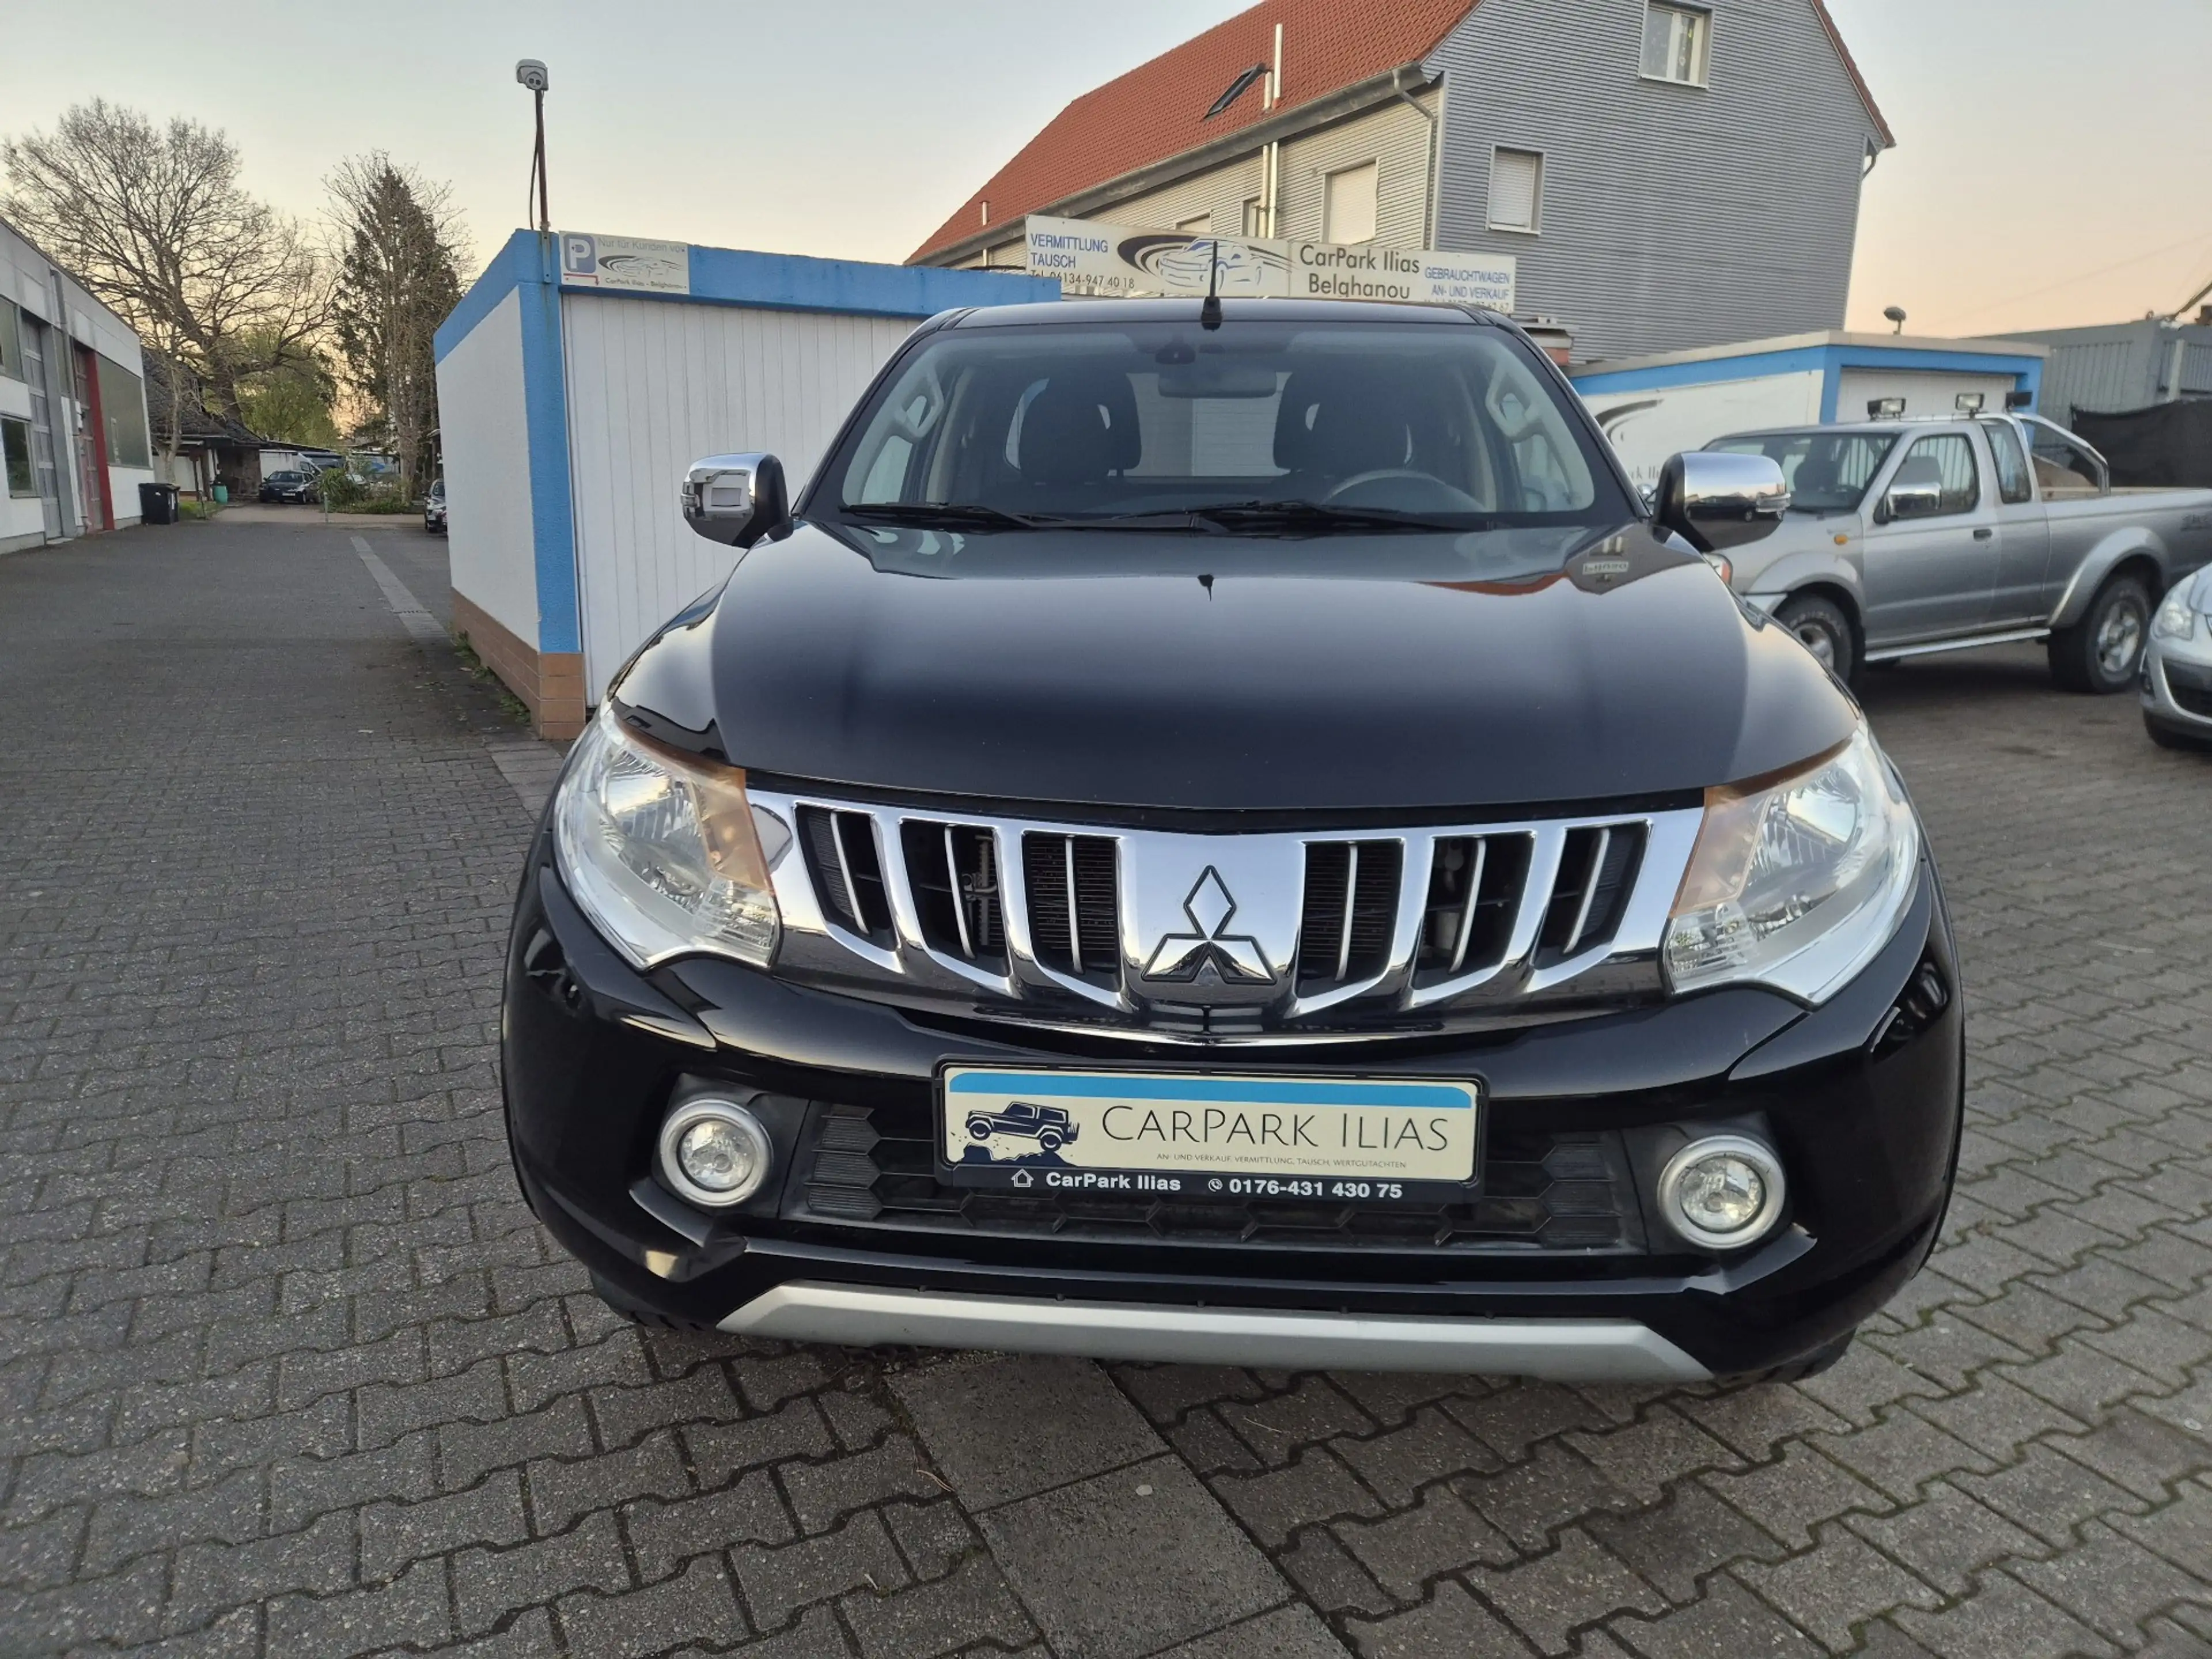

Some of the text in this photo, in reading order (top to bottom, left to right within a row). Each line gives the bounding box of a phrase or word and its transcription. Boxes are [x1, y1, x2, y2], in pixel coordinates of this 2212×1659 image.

[597, 237, 615, 248] Nur
[618, 238, 630, 249] für
[632, 241, 666, 252] Kunden
[1031, 233, 1108, 253] VERMITTLUNG
[569, 238, 591, 270] P
[1031, 252, 1076, 268] TAUSCH
[1300, 244, 1420, 274] CarPark Ilias
[1108, 277, 1120, 287] 40
[1123, 278, 1135, 289] 18
[1425, 267, 1510, 284] GEBRAUCHTWAGEN
[1309, 272, 1410, 299] Belghanou
[1431, 285, 1510, 300] AN- UND VERKAUF
[1333, 1160, 1407, 1168] WERTGUTACHTEN
[1046, 1172, 1181, 1191] CarPark Ilias
[1229, 1179, 1403, 1198] 0176-431 430 75
